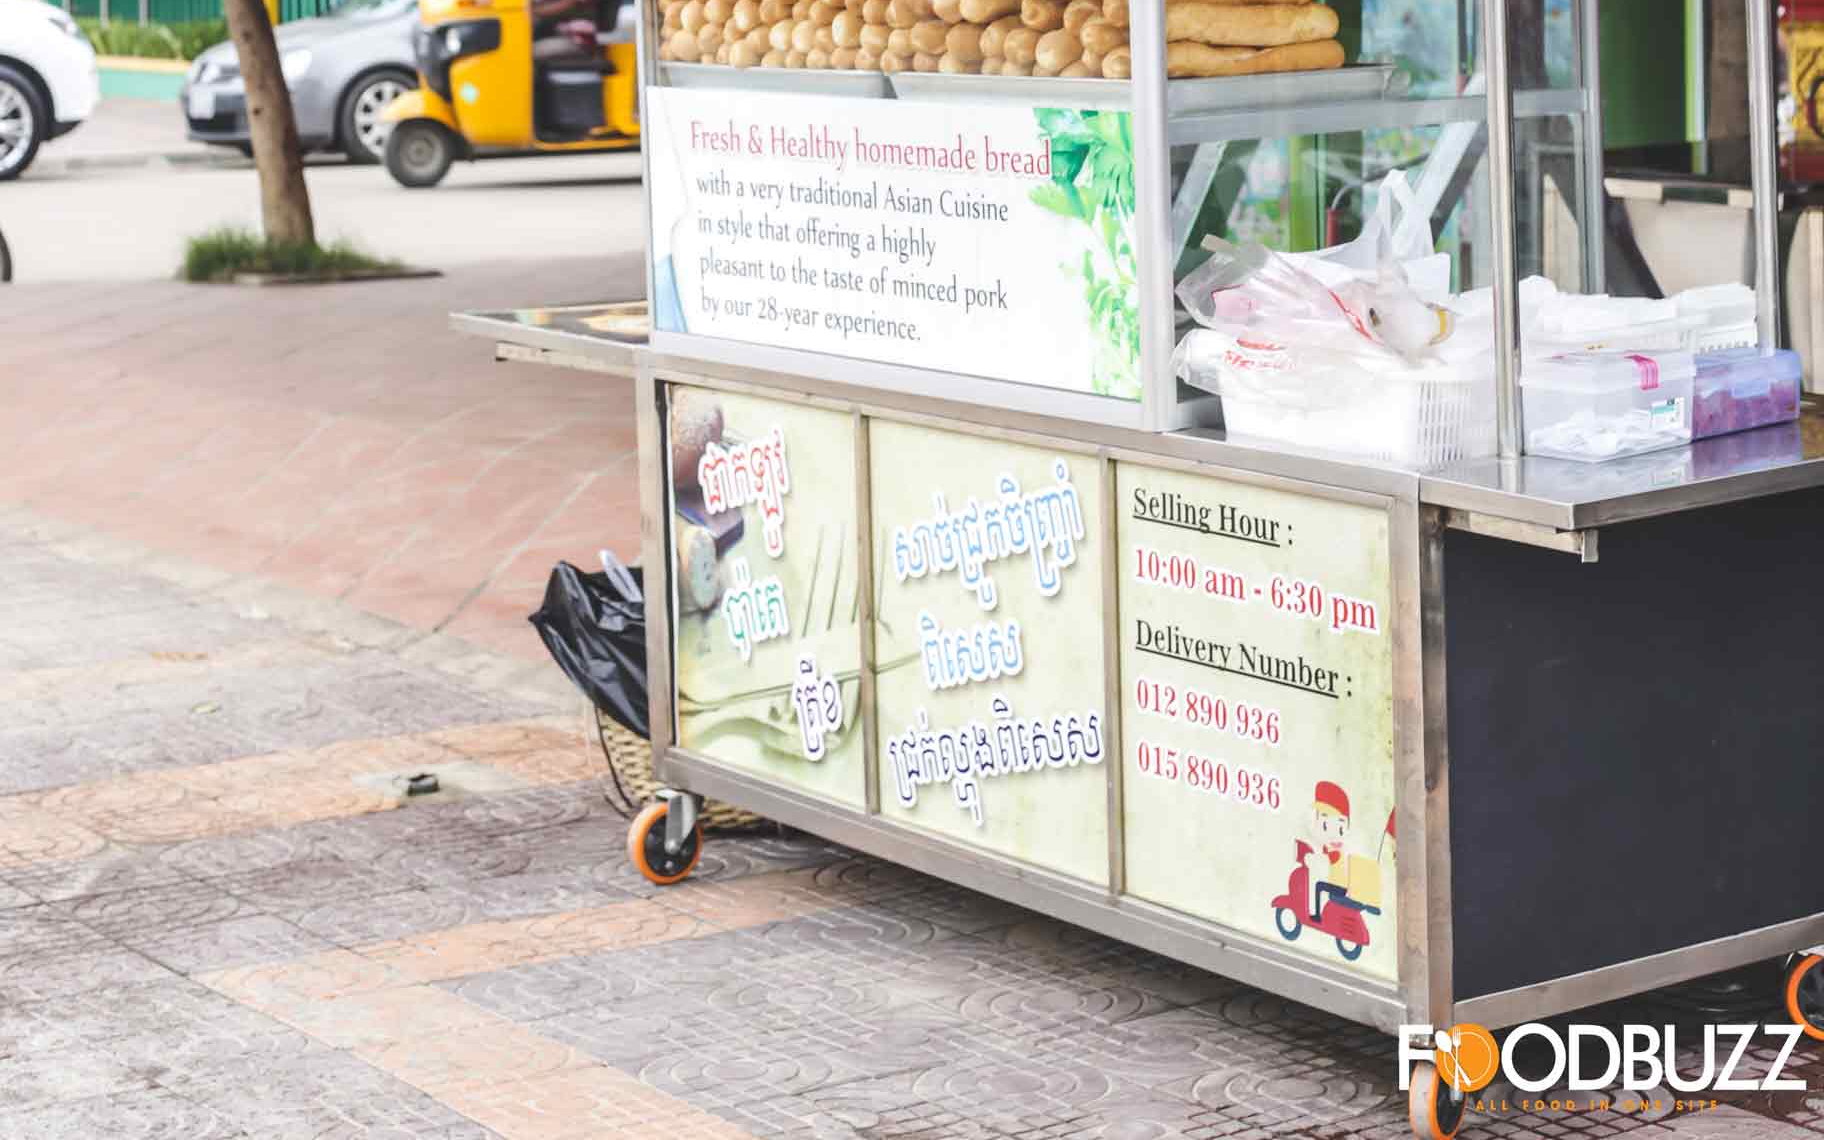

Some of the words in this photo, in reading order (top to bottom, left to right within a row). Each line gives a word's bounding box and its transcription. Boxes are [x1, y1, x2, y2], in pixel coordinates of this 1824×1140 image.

[690, 120, 740, 154] Fresh
[747, 124, 764, 155] &
[770, 124, 847, 171] Healthy
[853, 127, 976, 171] homemade
[984, 135, 1052, 176] bread
[696, 169, 731, 197] with
[736, 181, 745, 198] a
[750, 180, 784, 210] very
[790, 176, 878, 210] traditional
[883, 185, 933, 216] Asian
[939, 190, 1009, 222] Cuisine
[698, 210, 713, 234] in
[717, 209, 753, 245] style
[757, 213, 790, 243] that
[796, 216, 861, 259] offering
[866, 234, 876, 253] a
[881, 224, 937, 267] highly
[699, 246, 764, 281] pleasant
[769, 257, 787, 282] to
[791, 255, 818, 288] the
[823, 265, 863, 293] taste
[869, 266, 889, 295] of
[892, 273, 958, 304] minced
[964, 278, 1009, 315] pork
[700, 286, 719, 322] by
[724, 298, 752, 318] our
[756, 296, 819, 332] 28-year
[824, 310, 922, 342] experience.
[1133, 488, 1211, 533] Selling
[1219, 504, 1280, 542] Hour
[1136, 548, 1196, 589] 10:00
[1205, 569, 1246, 601] am
[1271, 576, 1322, 618] 6:30
[1332, 595, 1377, 630] pm
[1136, 619, 1232, 671] Delivery
[1239, 643, 1339, 693] Number
[1137, 679, 1177, 718] 012
[1186, 690, 1227, 731] 890
[1236, 704, 1280, 745] 936
[1138, 741, 1178, 781] 015
[1187, 755, 1228, 794] 890
[1238, 769, 1281, 810] 936
